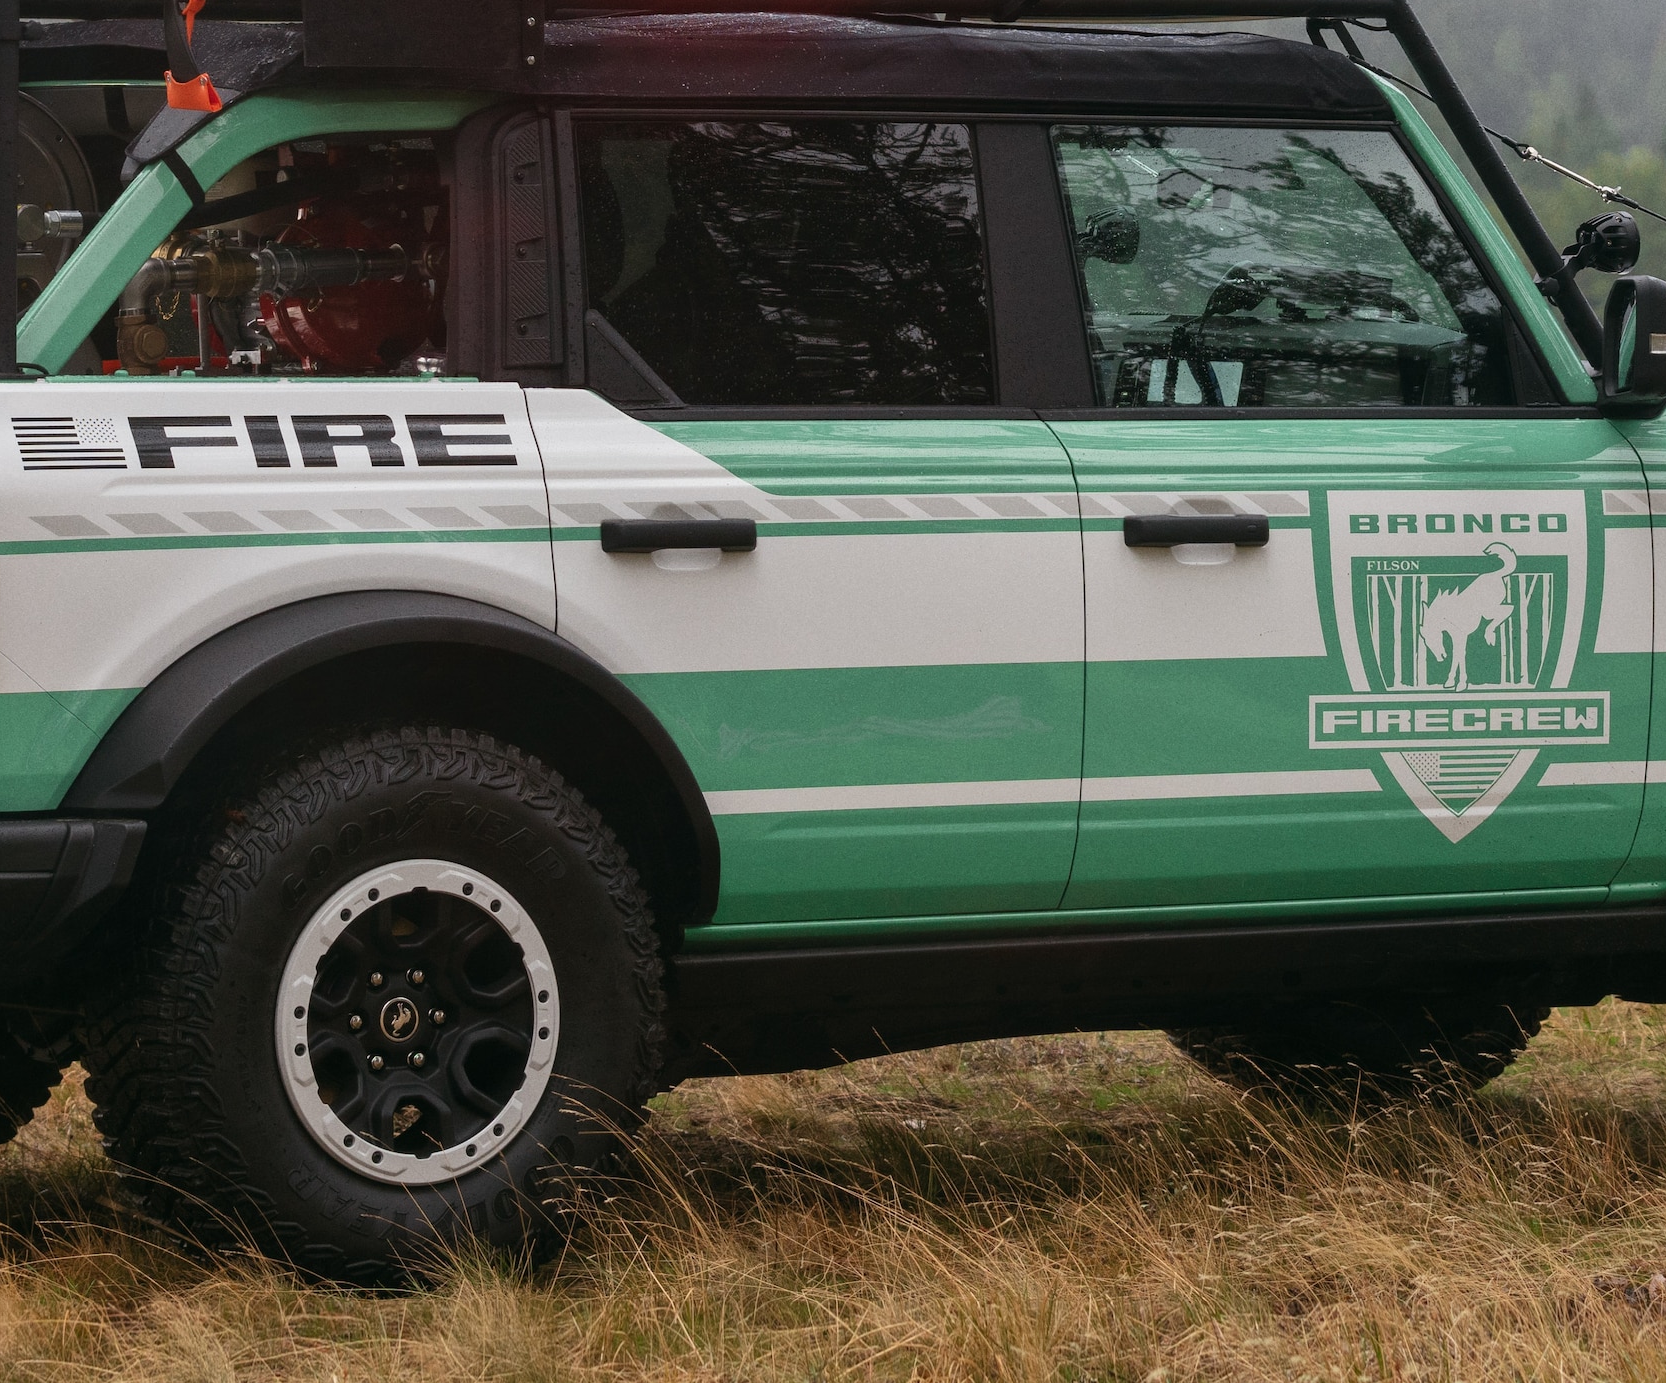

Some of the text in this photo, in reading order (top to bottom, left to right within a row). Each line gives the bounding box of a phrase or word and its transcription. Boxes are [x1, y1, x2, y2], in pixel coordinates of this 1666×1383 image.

[127, 413, 518, 469] FIRE
[1349, 513, 1568, 534] BRONCO
[1366, 559, 1420, 572] FILSON
[1322, 707, 1598, 734] FIRECREW
